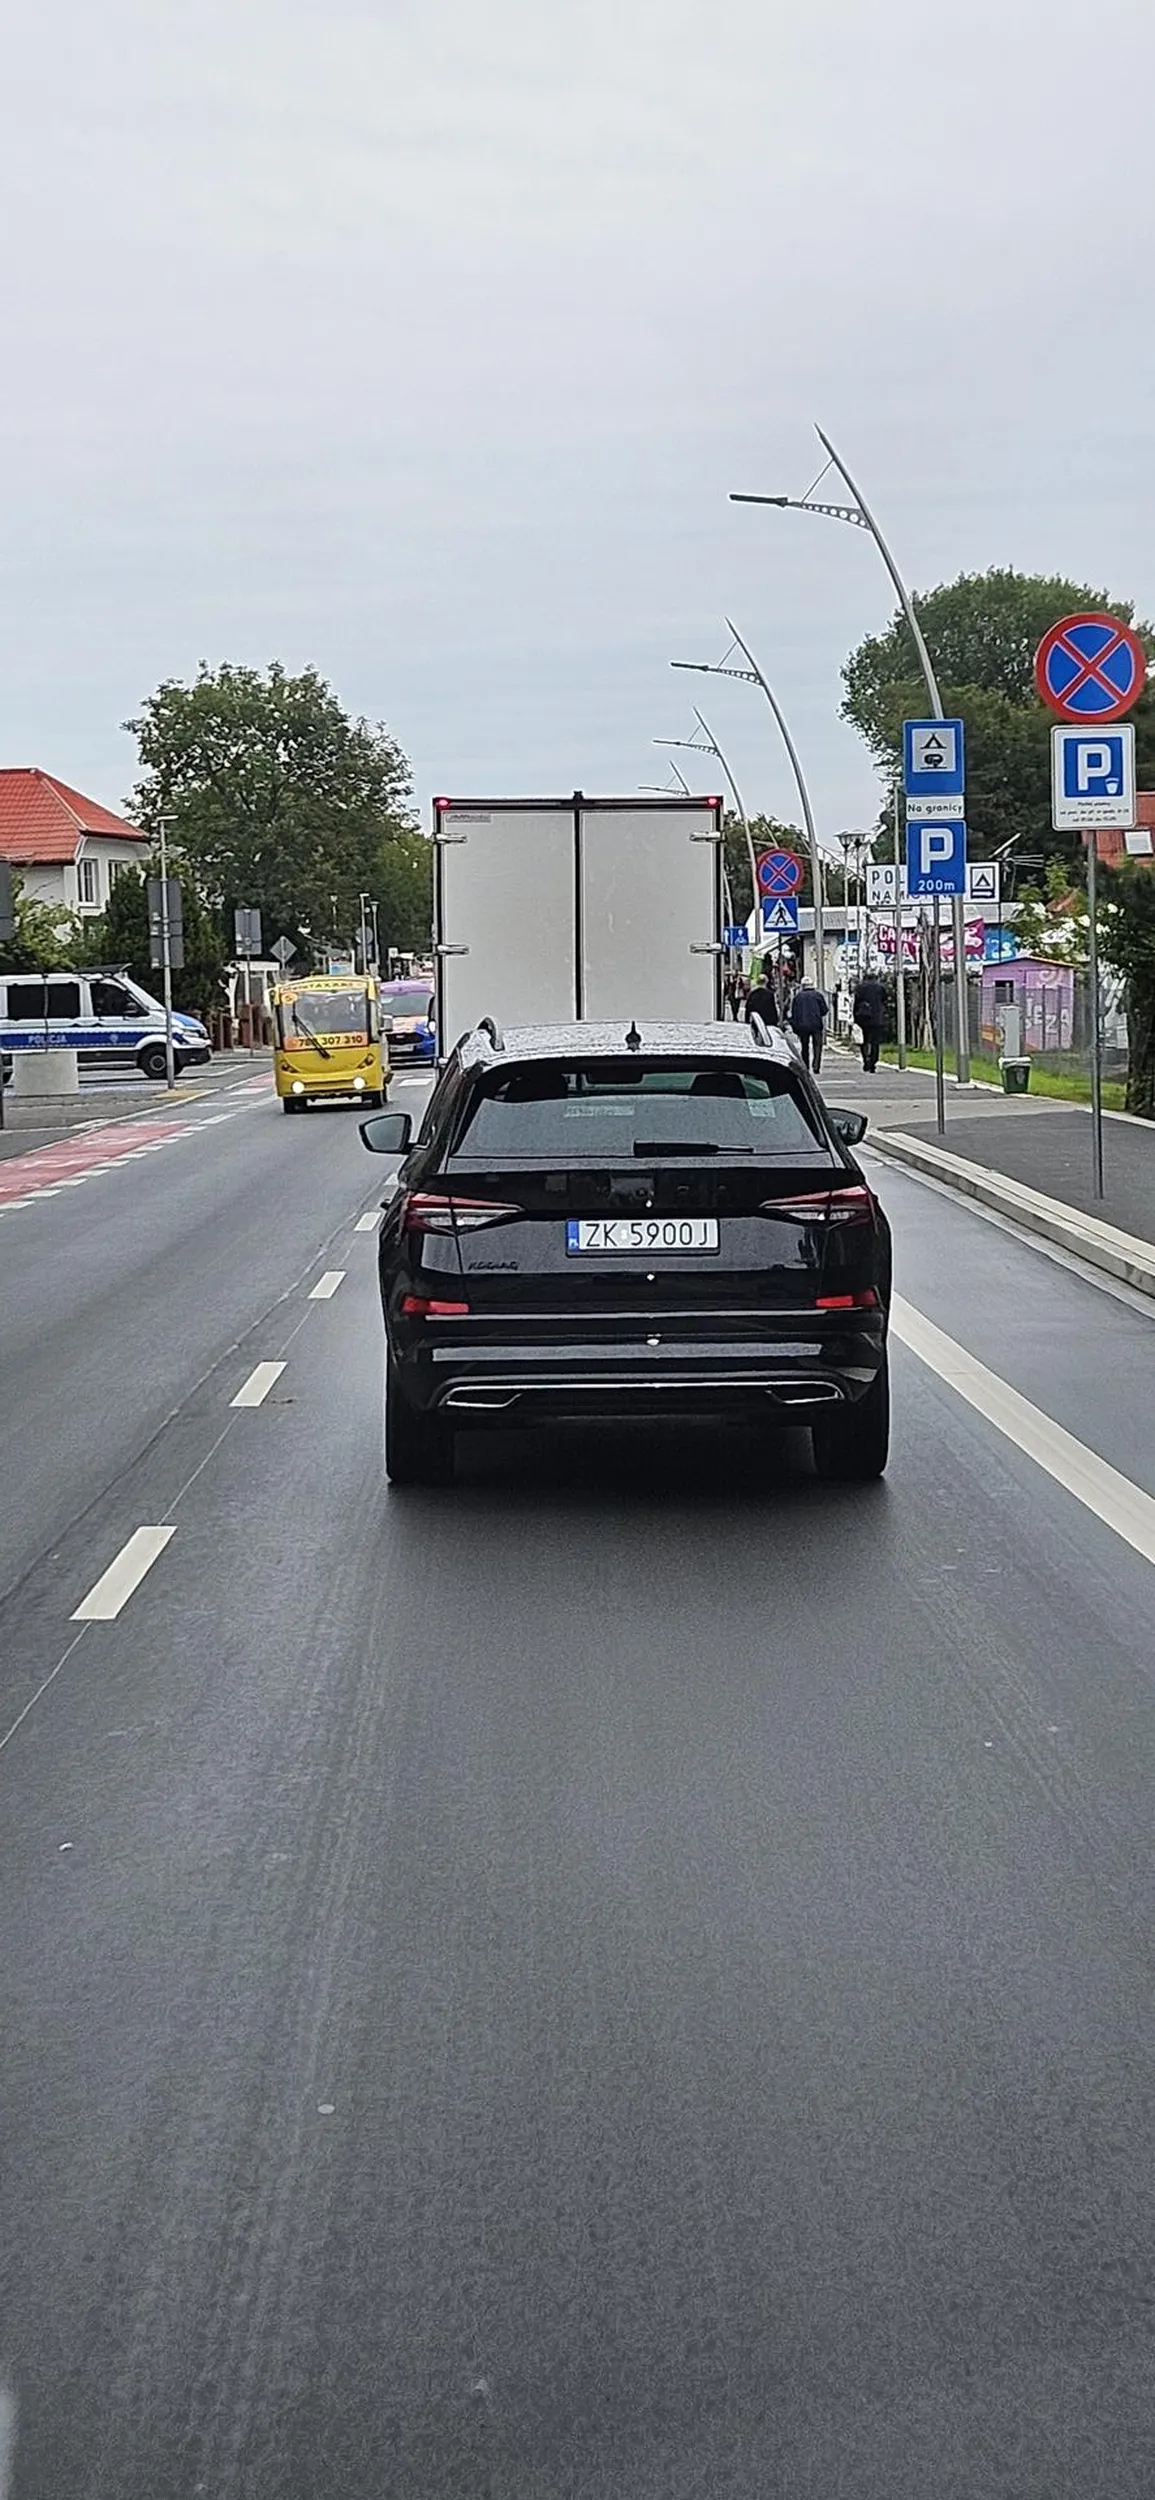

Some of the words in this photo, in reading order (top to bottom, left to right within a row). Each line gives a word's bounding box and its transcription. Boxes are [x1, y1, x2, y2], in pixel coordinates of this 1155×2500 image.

[1078, 744, 1111, 791] P
[907, 804, 923, 813] Na
[926, 803, 963, 815] granicy
[920, 828, 954, 874] P
[918, 880, 955, 892] 200m
[321, 1036, 341, 1046] 307
[585, 1223, 617, 1247] ZK
[630, 1222, 708, 1247] 5900J
